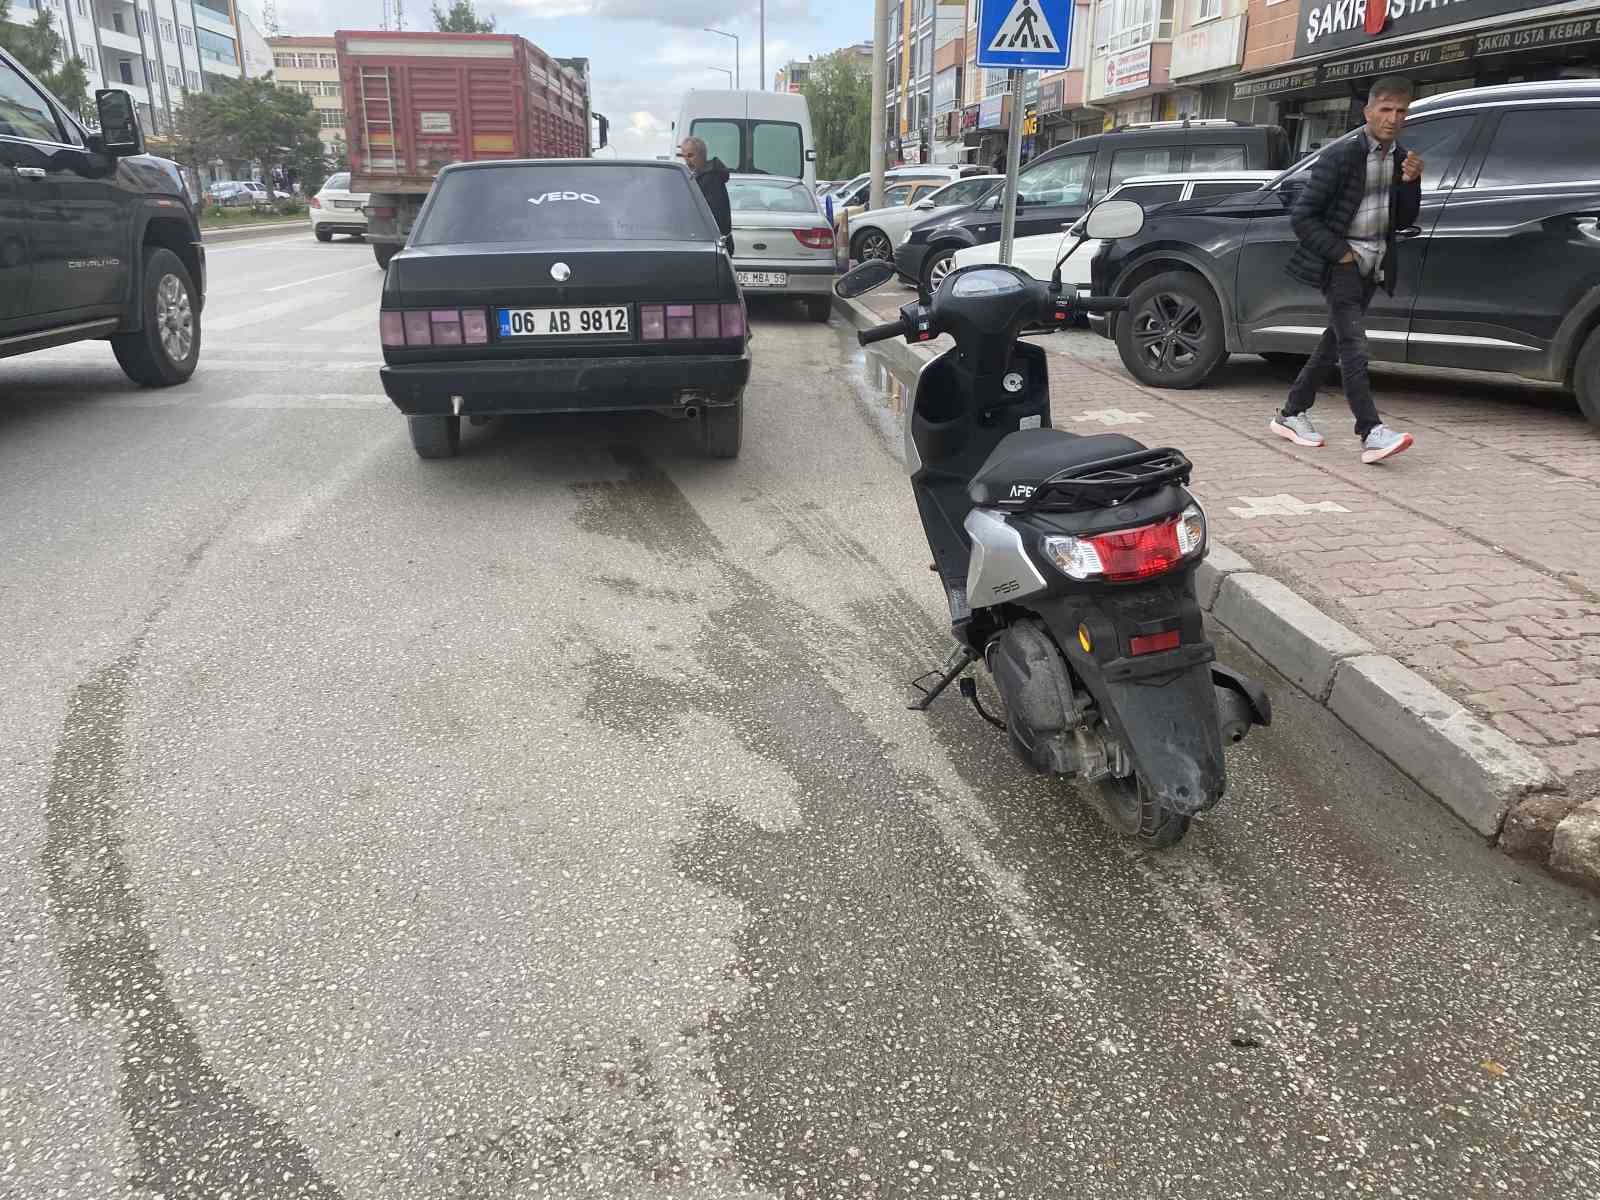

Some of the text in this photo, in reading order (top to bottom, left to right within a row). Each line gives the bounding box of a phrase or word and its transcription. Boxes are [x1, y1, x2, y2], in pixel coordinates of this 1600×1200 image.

[1514, 30, 1545, 45] USTA
[1549, 21, 1592, 40] KEBAP
[1378, 55, 1409, 69] KEBAP
[528, 191, 600, 204] VEDO
[774, 273, 785, 284] 59
[512, 308, 626, 333] 06 AB 9812
